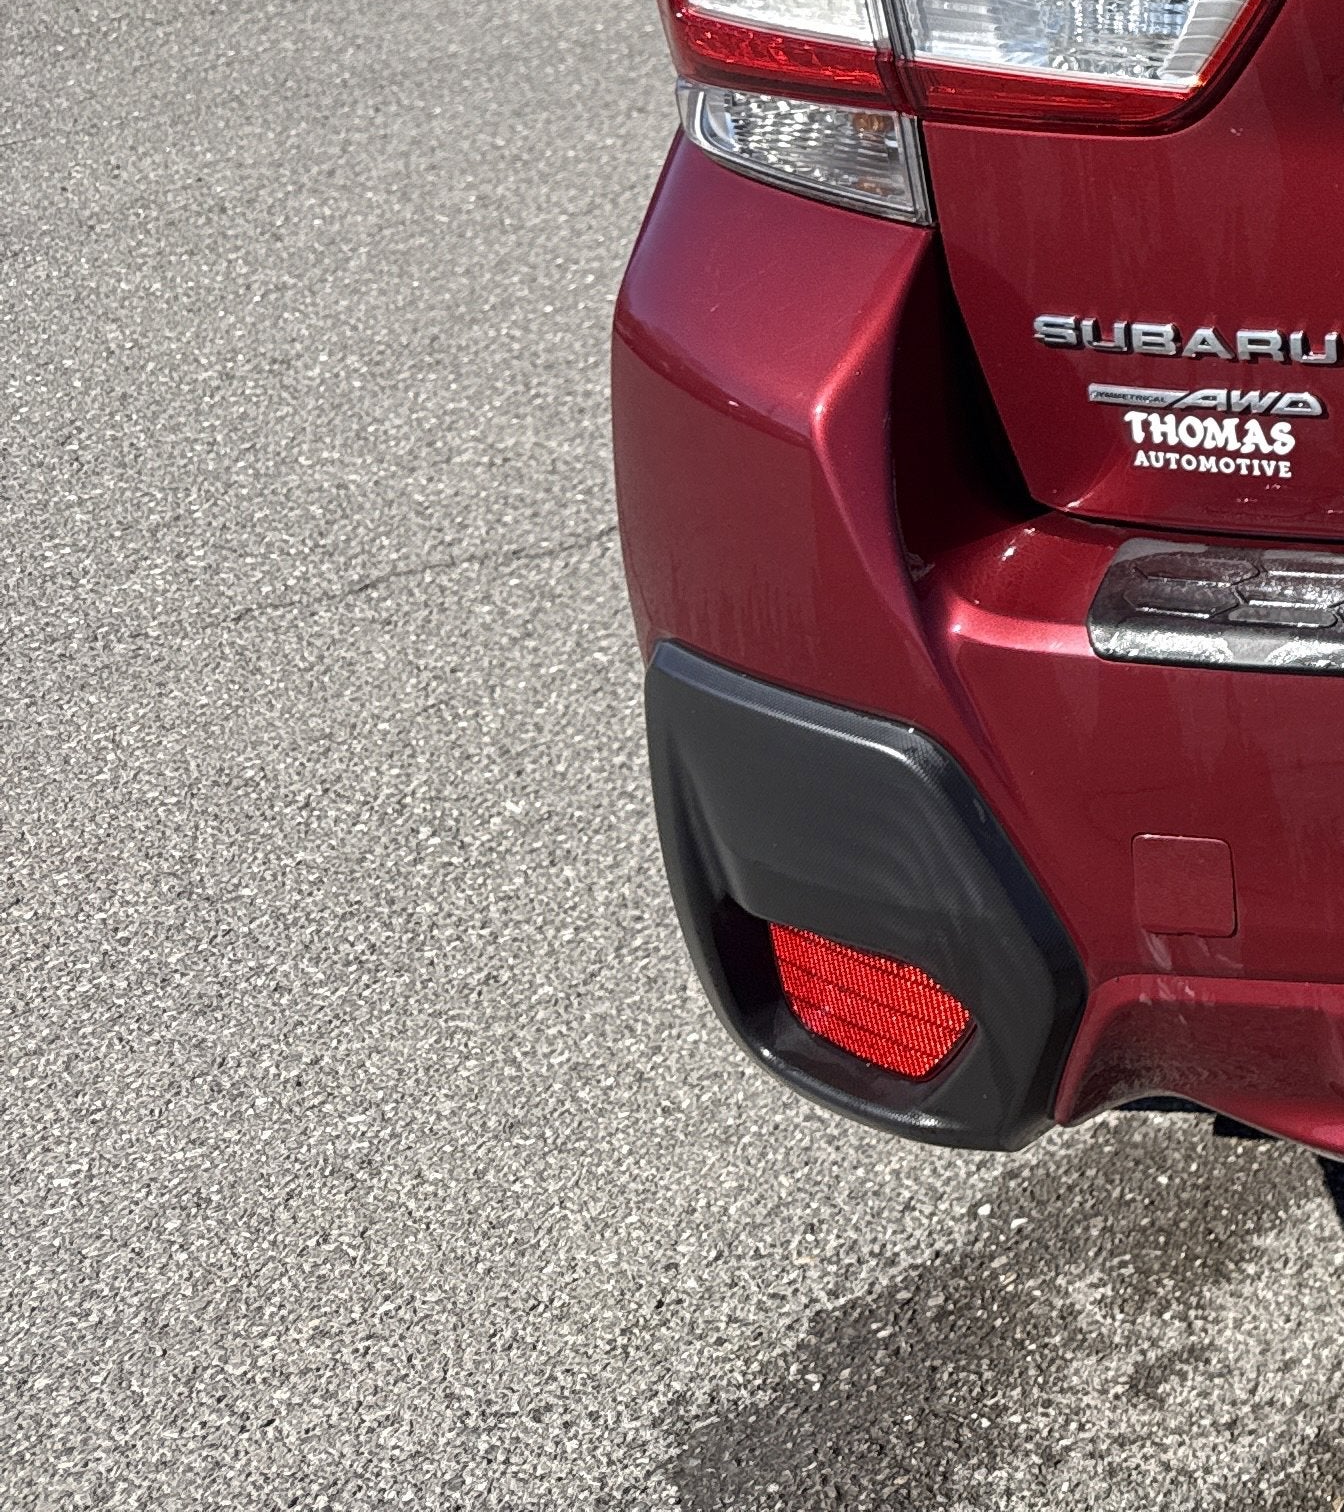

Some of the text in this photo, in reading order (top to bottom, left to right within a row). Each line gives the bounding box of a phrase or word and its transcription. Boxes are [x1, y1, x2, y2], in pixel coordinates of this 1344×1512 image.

[1033, 314, 1339, 365] SUBARU
[1173, 388, 1323, 416] AWD
[1124, 411, 1295, 455] THOMAS
[1134, 450, 1292, 478] AUTOMOTIVE
